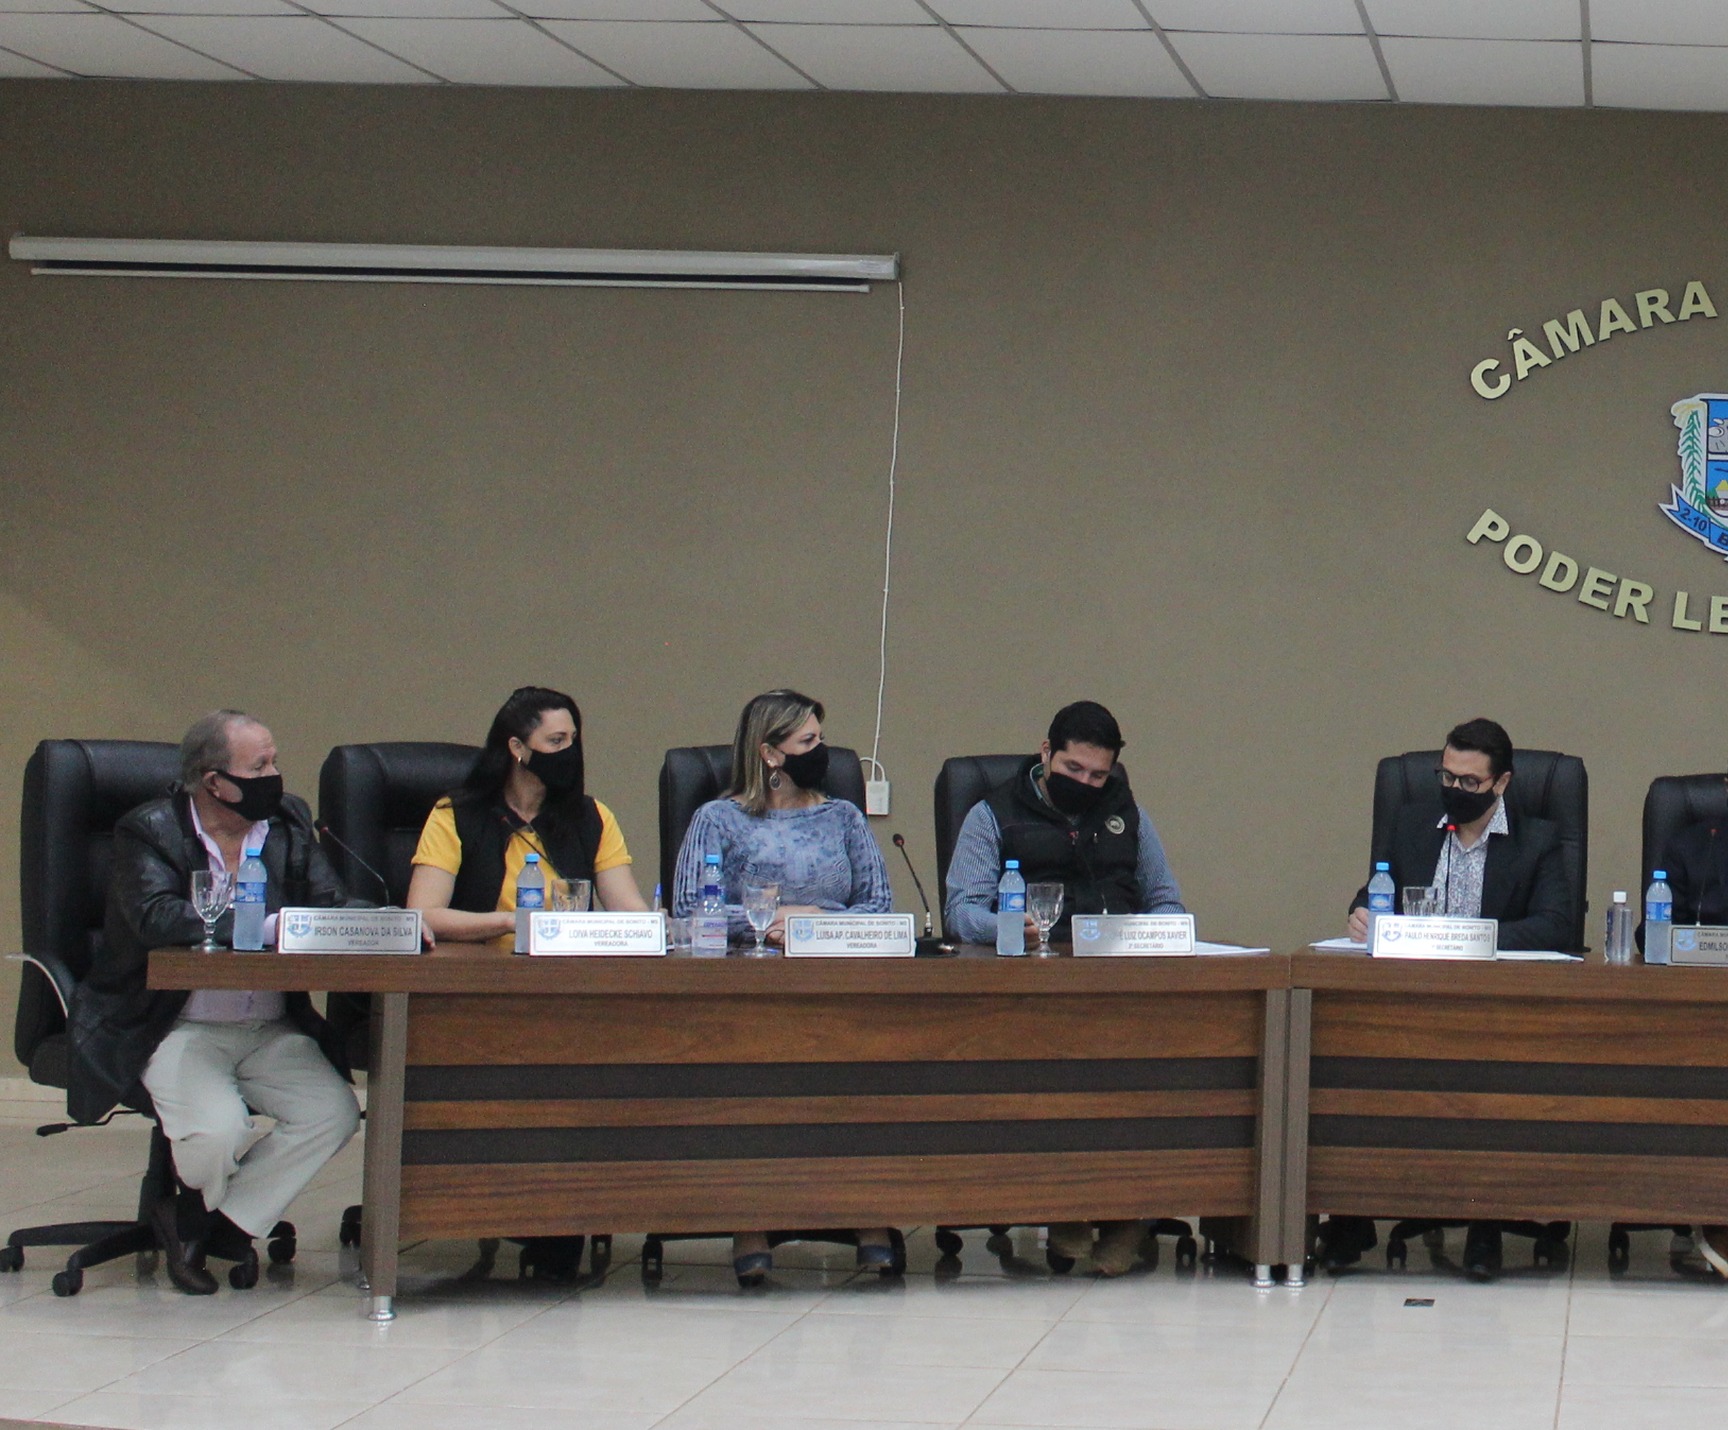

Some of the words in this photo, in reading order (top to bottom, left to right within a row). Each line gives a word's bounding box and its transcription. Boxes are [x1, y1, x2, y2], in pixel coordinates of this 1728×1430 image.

[1469, 278, 1718, 400] CÂMARA
[1679, 508, 1708, 533] 2-10
[1466, 508, 1655, 623] PODER
[314, 926, 338, 936] IRSON
[339, 926, 378, 937] CASANOVA
[381, 926, 391, 937] DA
[393, 926, 413, 937] SILVA
[845, 930, 883, 940] CAVALHEIRO
[884, 930, 894, 940] DE
[1404, 931, 1423, 940] PAULO
